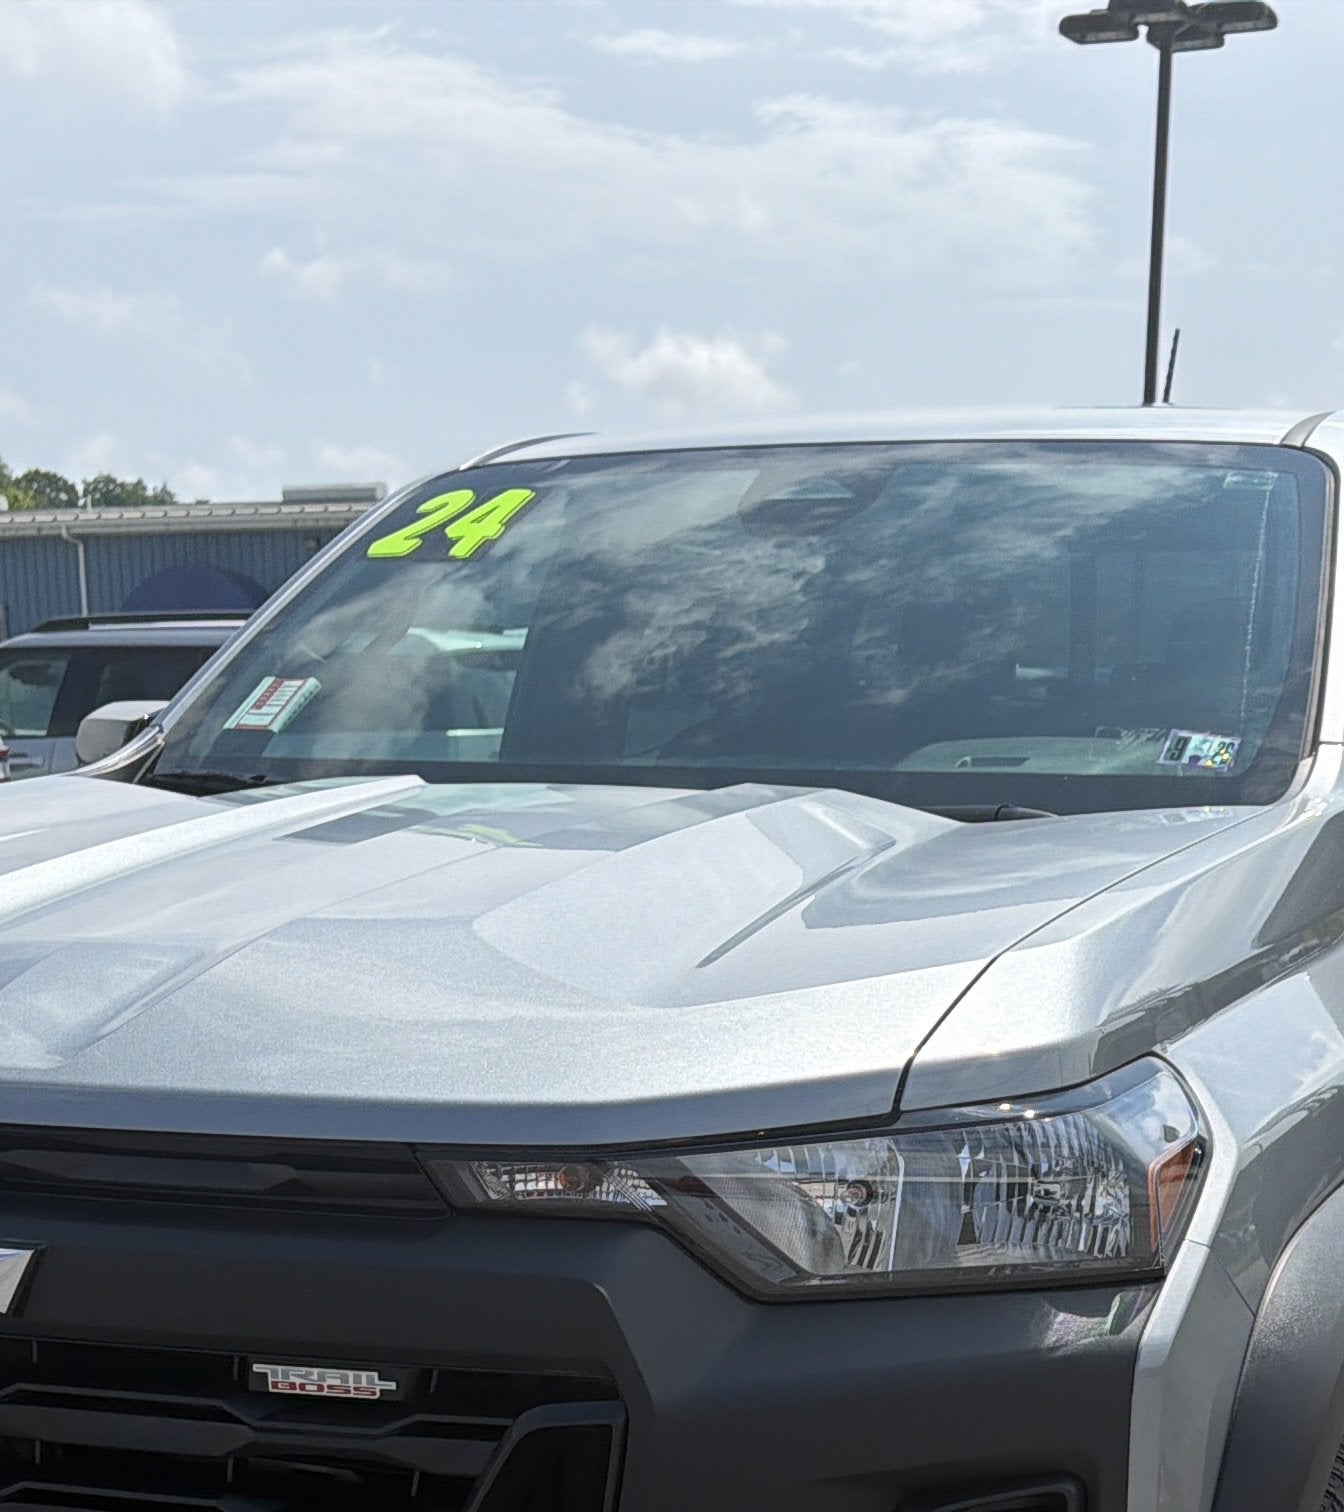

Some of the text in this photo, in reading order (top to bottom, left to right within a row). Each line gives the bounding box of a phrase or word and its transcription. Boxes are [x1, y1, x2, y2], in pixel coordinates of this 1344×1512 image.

[366, 488, 537, 560] 24
[253, 1363, 397, 1390] TRAIL
[270, 1380, 379, 1397] BOSS
